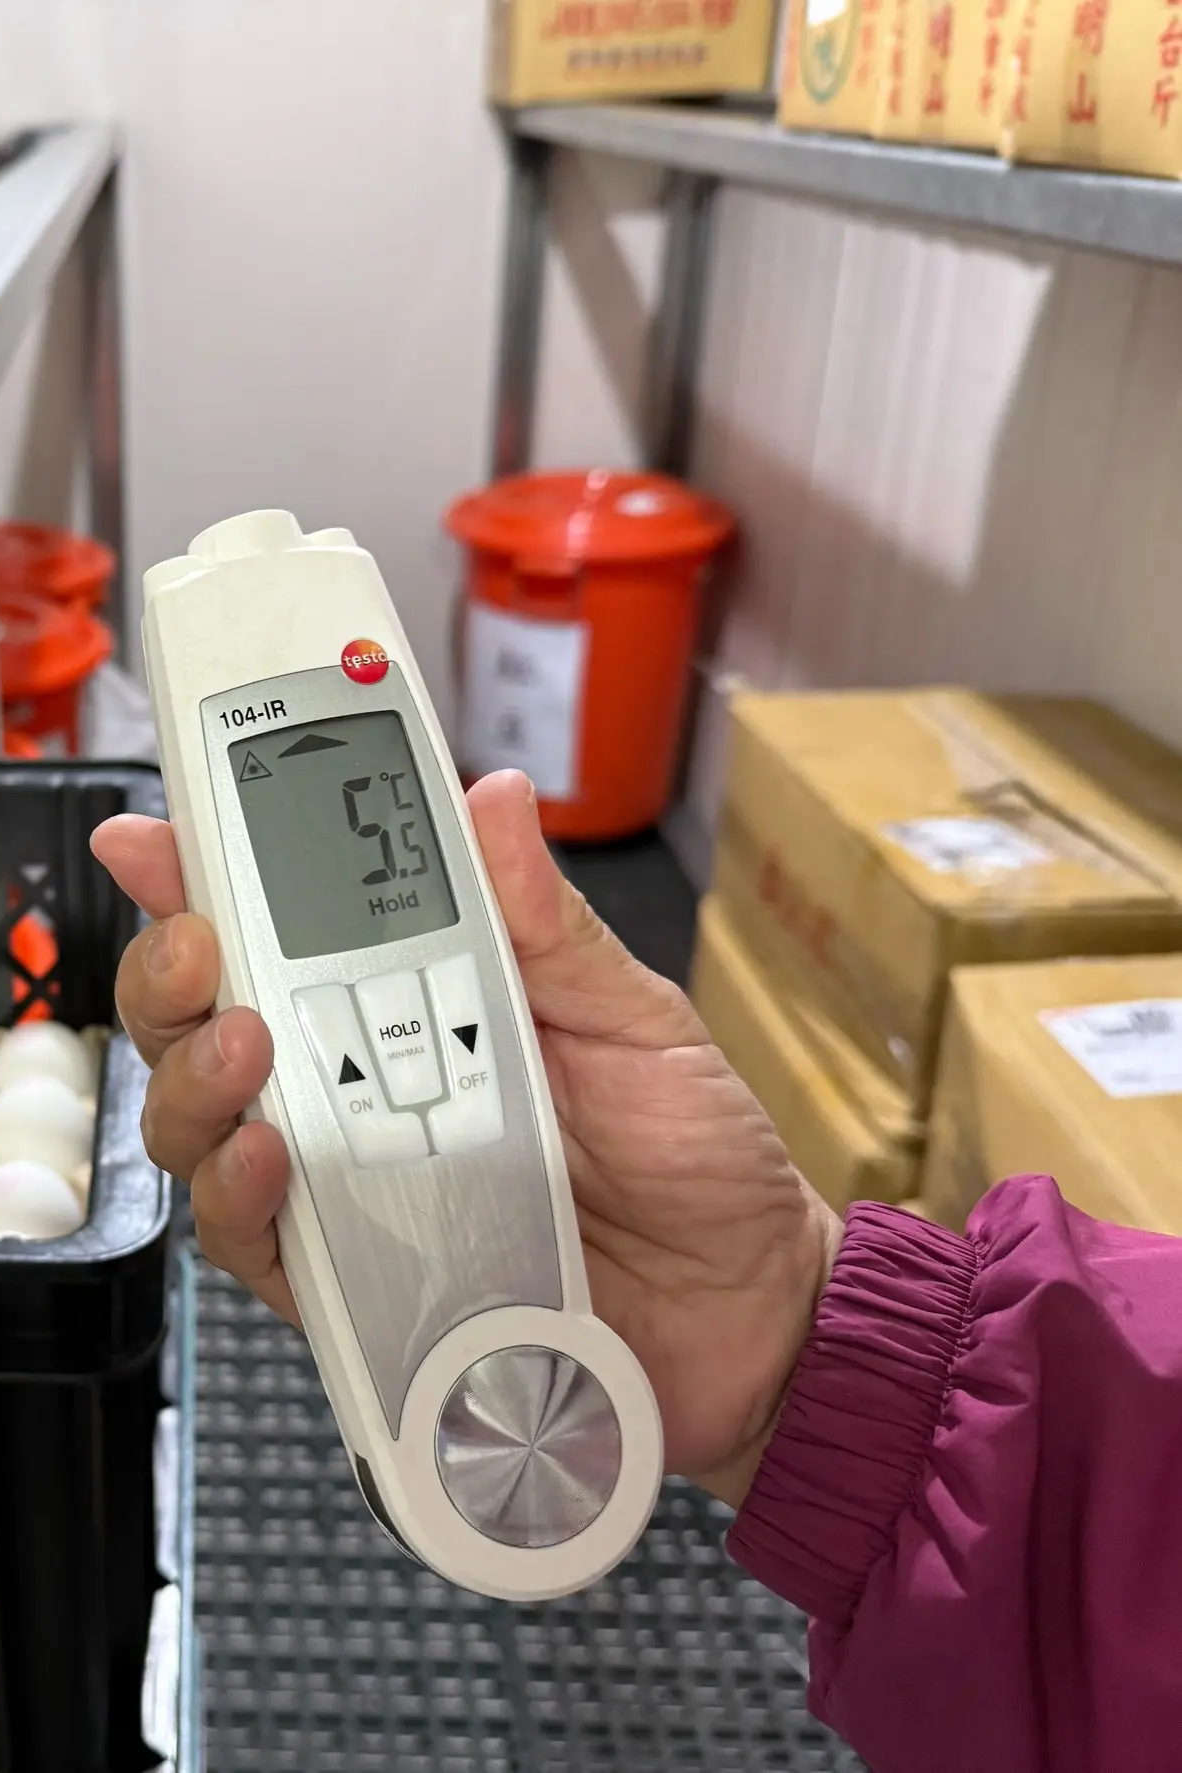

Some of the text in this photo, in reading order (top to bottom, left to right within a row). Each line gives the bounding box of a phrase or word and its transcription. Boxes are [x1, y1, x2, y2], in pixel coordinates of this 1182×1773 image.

[343, 651, 388, 669] testo
[219, 699, 287, 729] 104-IR
[342, 776, 429, 886] 5.5
[369, 889, 420, 916] Hold
[379, 1020, 421, 1041] HOLD
[387, 1045, 426, 1061] MIN/MAX
[459, 1071, 489, 1090] OFF
[349, 1097, 374, 1115] ON
